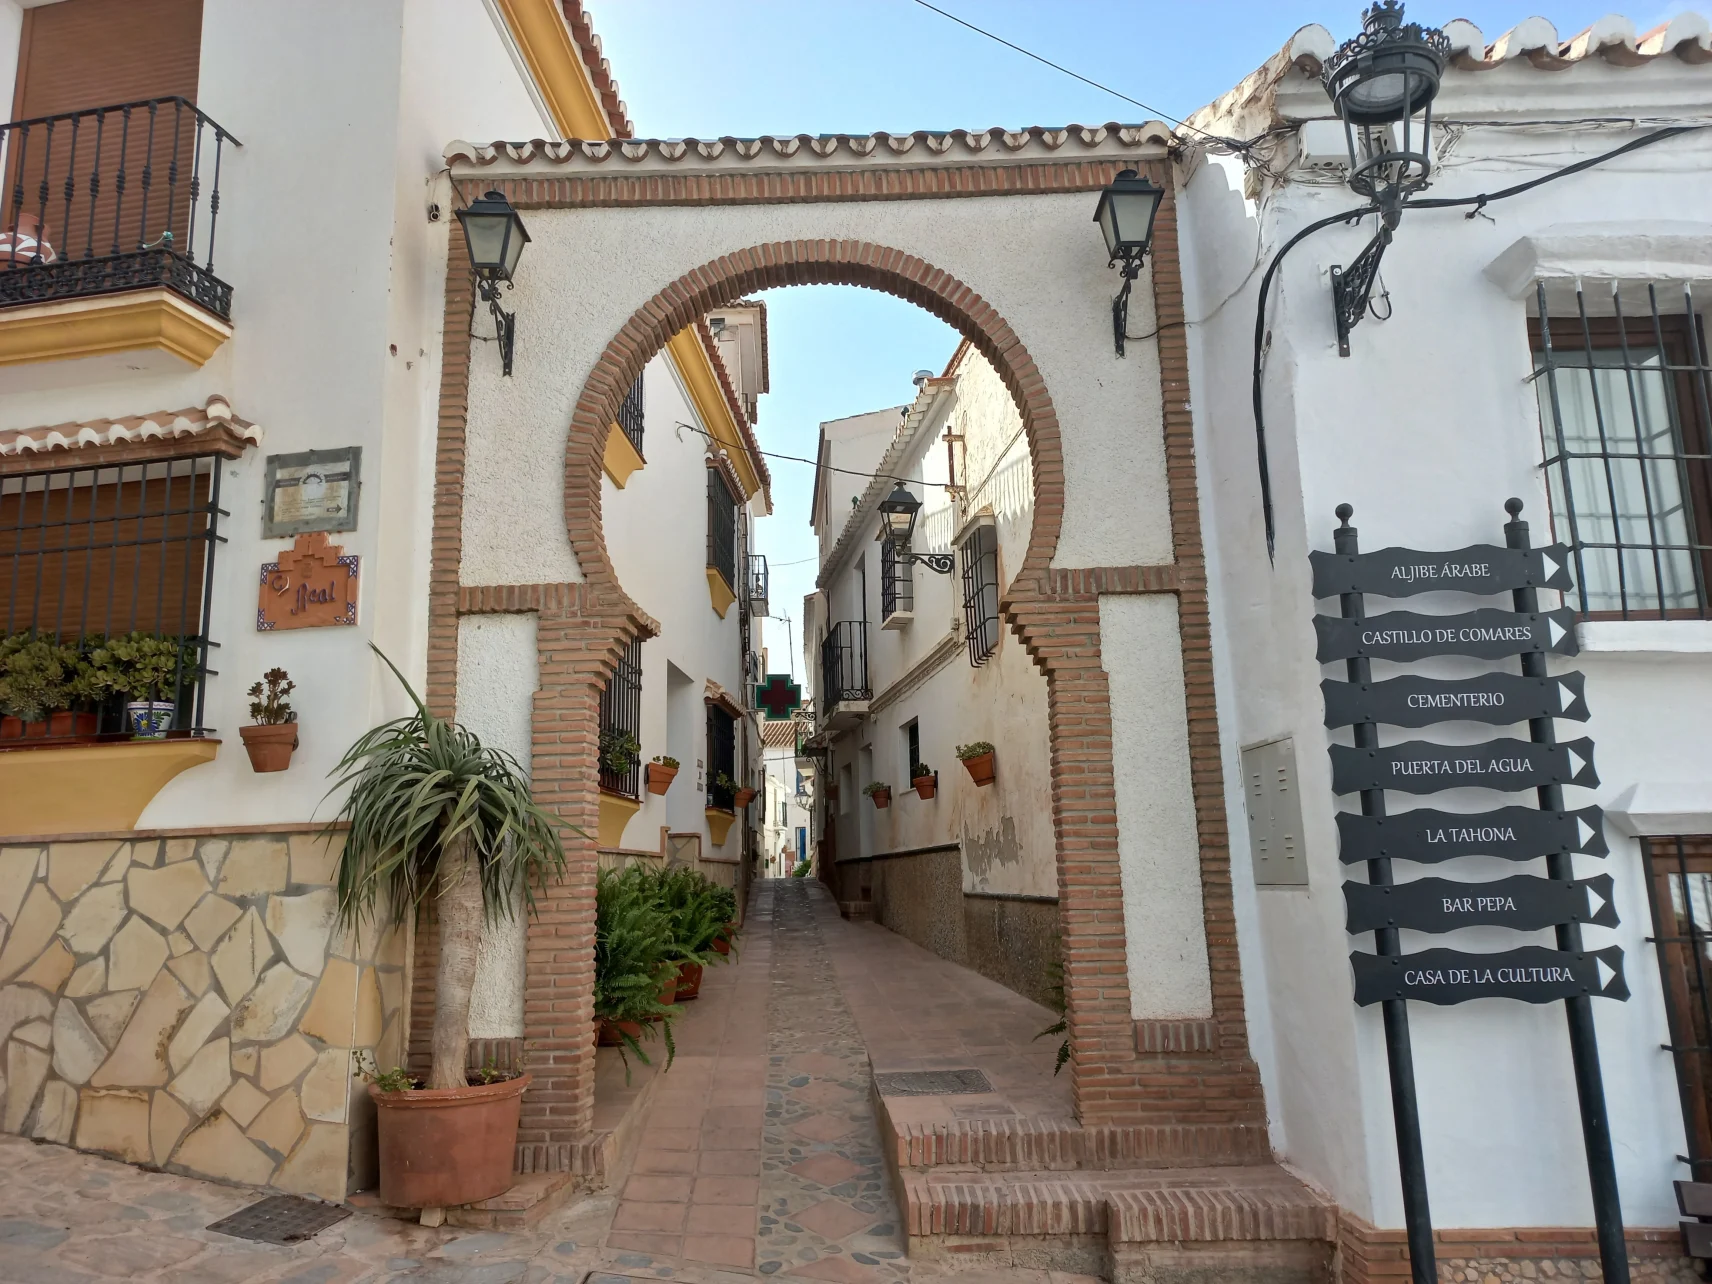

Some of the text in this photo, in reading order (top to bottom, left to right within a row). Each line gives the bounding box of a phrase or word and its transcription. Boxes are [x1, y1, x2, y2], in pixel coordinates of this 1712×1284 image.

[1390, 561, 1491, 583] ALJIBE ÁRABE
[291, 580, 336, 615] Real
[1362, 626, 1532, 645] CASTILLO DE COMARES
[1407, 692, 1505, 708] CEMENTERIO
[1391, 758, 1534, 775] PUERTA DEL AGUA
[1425, 827, 1517, 843] LA TAHONA
[1442, 896, 1518, 913] BAR PEPA
[1404, 966, 1575, 986] CASA DE LA CULTURA
